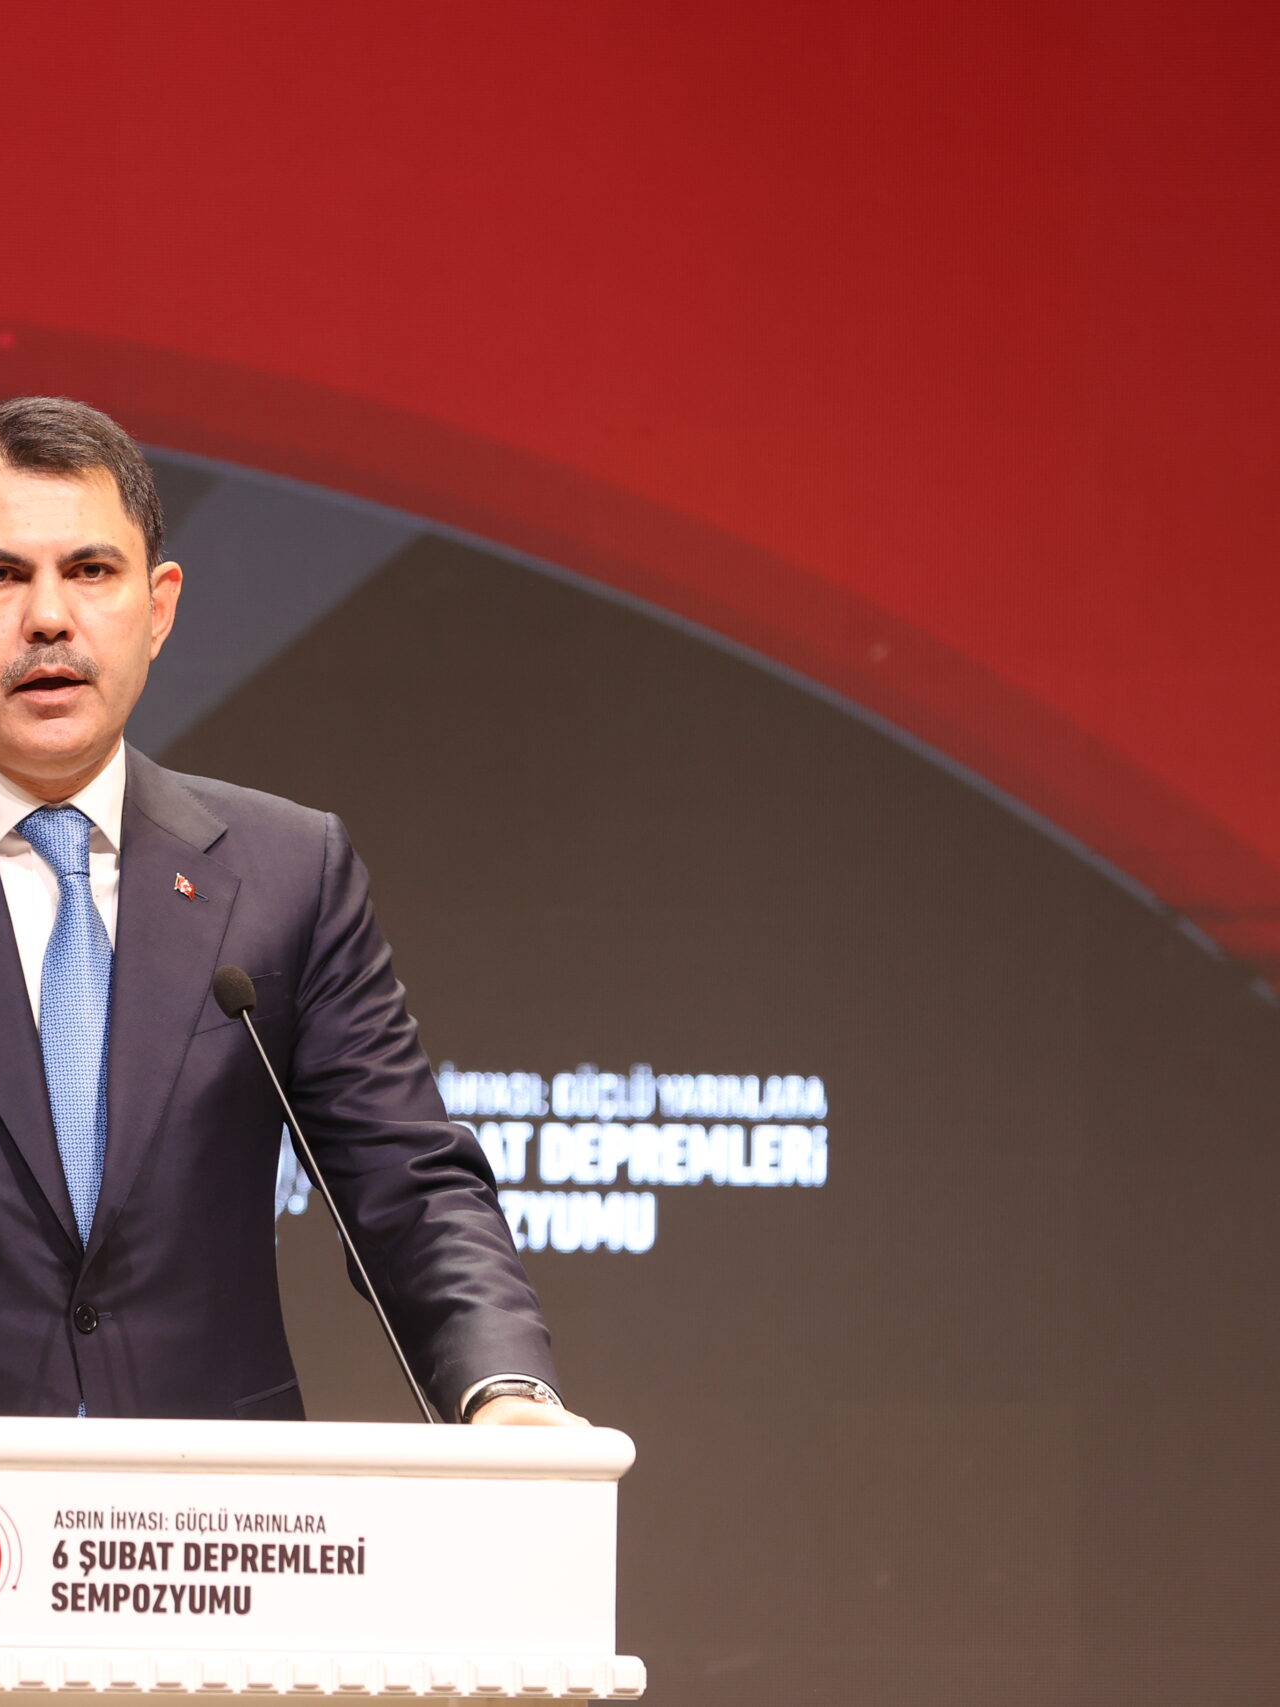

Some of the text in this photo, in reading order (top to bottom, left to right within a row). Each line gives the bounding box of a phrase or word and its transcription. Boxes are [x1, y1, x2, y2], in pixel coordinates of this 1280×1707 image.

[539, 1122, 828, 1187] DEPREMLERİ
[53, 1506, 326, 1535] ASRIN İHYASI: GÜÇLÜ YARINLARA
[52, 1536, 365, 1577] 6 ŞUBAT DEPREMLERİ
[51, 1582, 252, 1616] SEMPOZYUMU
